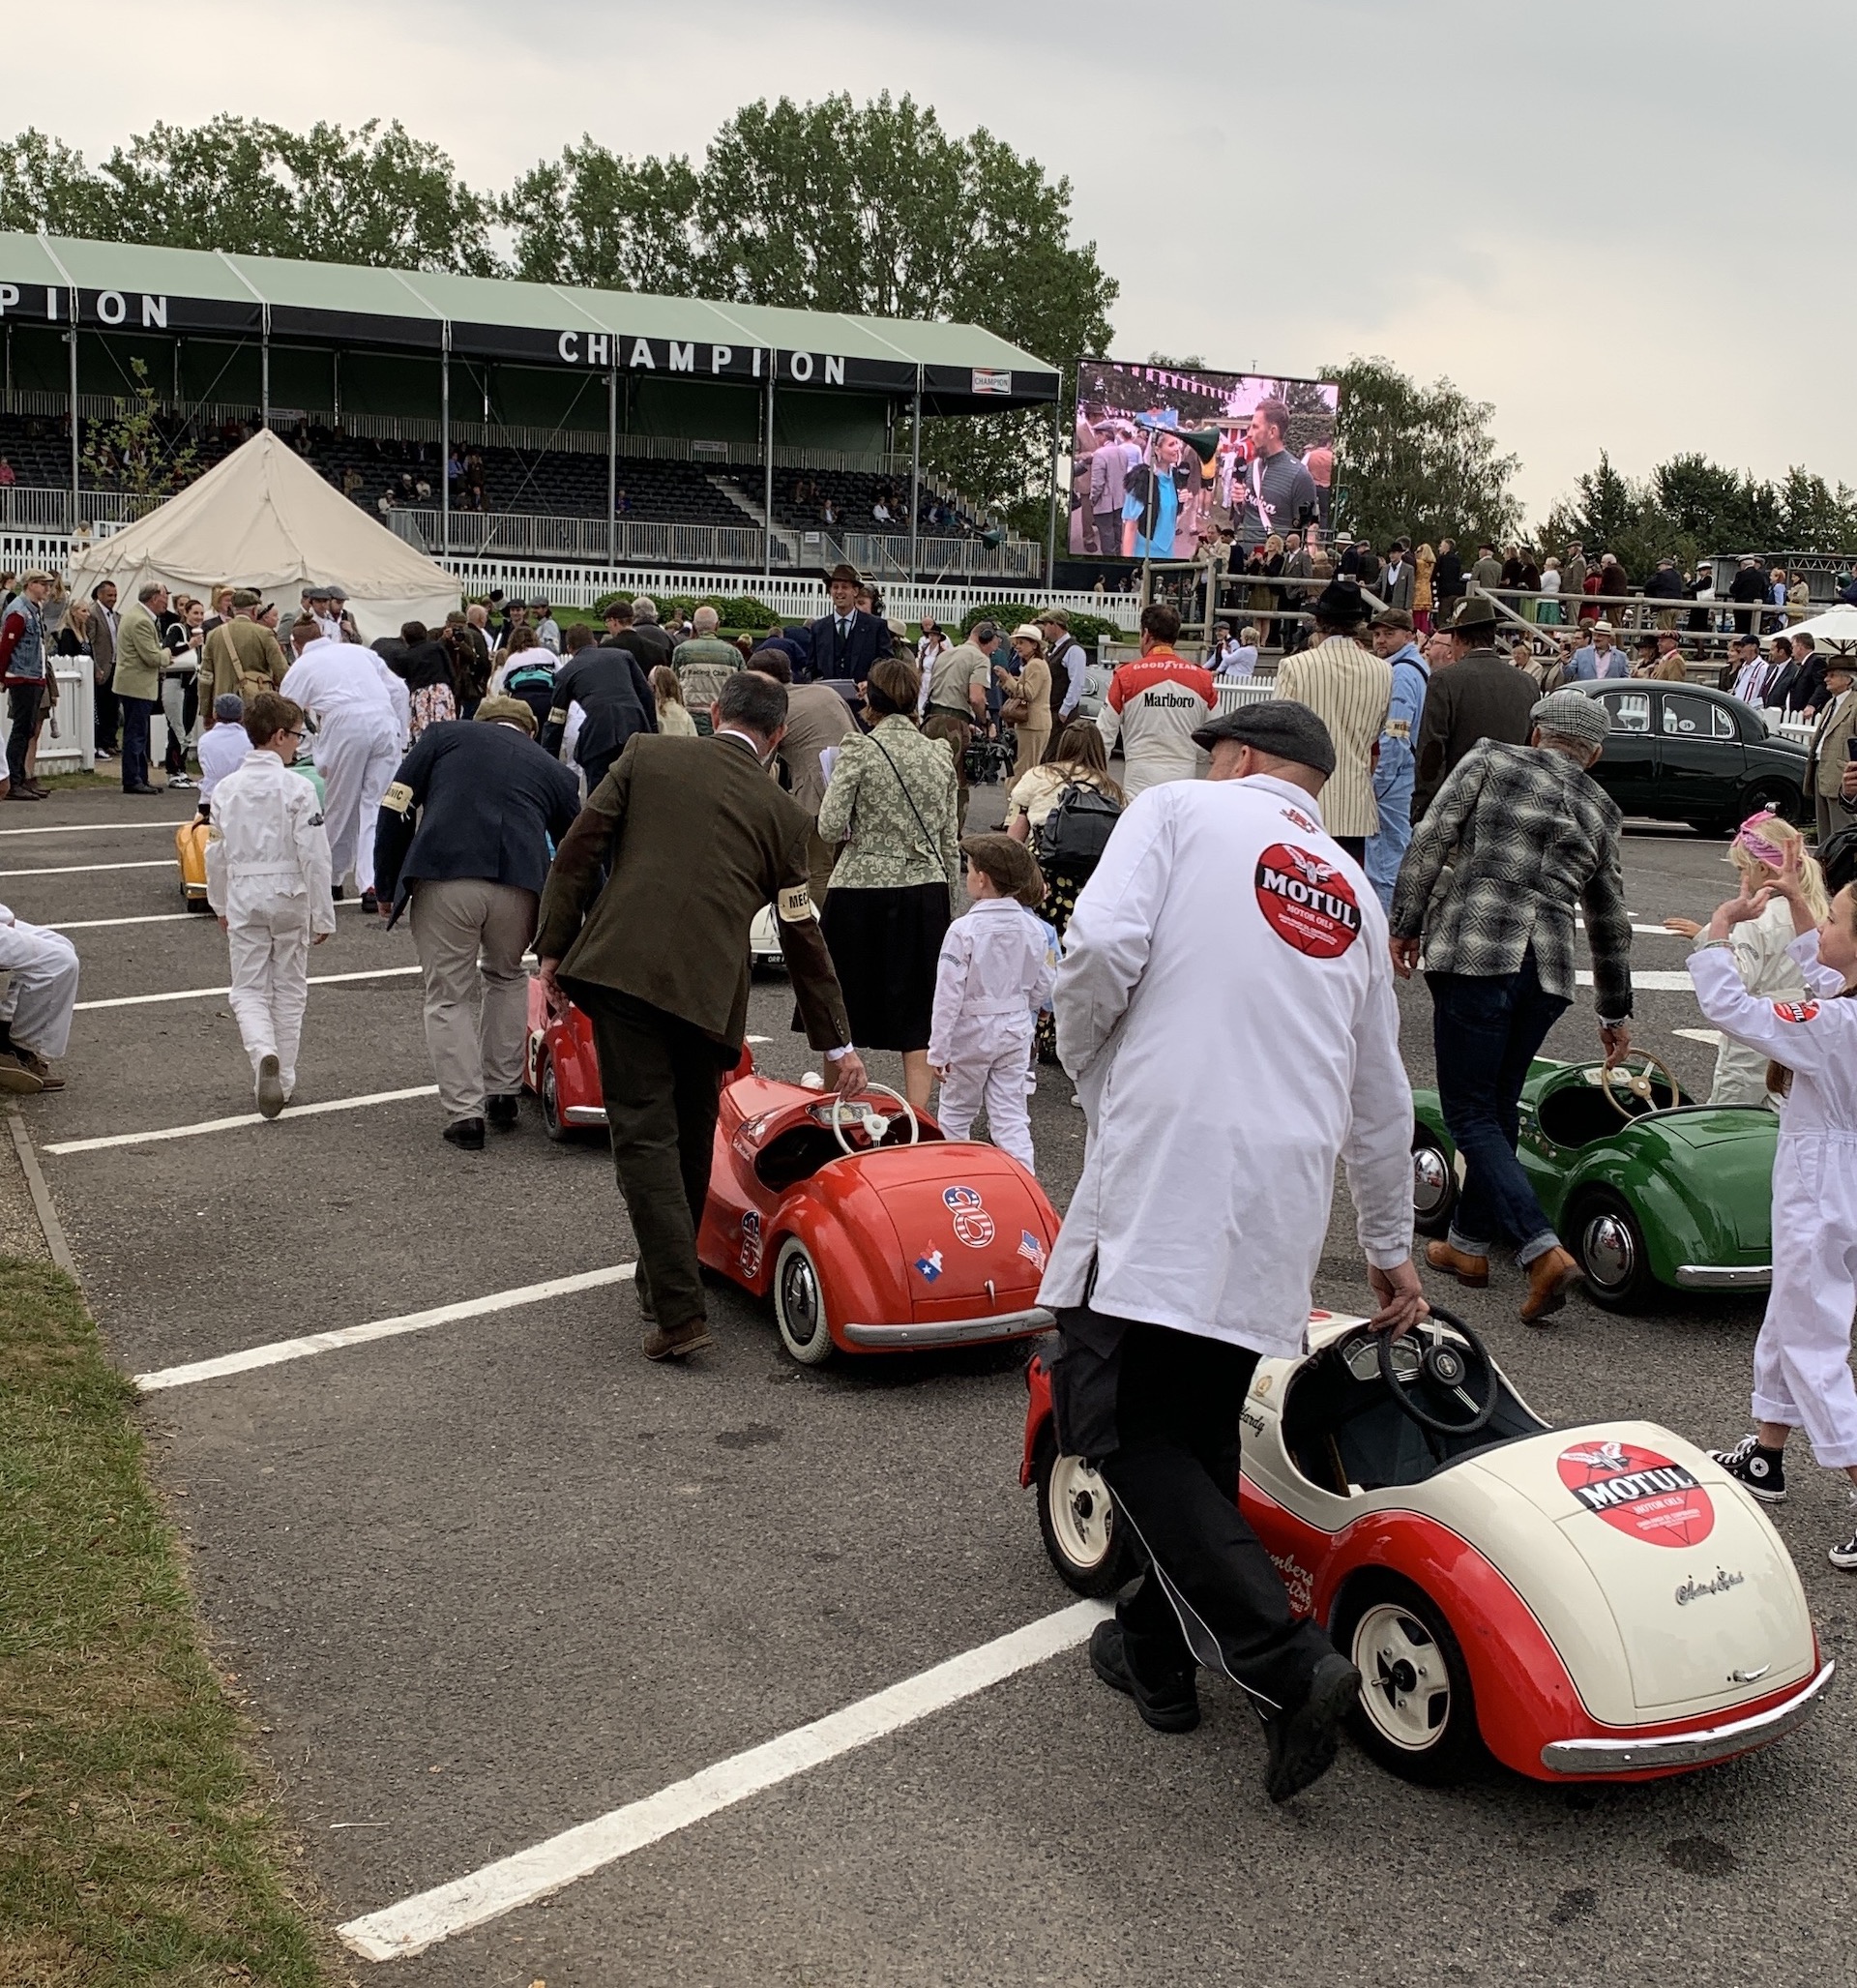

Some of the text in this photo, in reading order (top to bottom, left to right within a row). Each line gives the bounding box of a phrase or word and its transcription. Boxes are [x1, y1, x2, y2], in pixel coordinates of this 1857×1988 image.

[558, 331, 845, 386] CHAMPION
[974, 376, 1008, 387] CHAMPION
[688, 668, 711, 677] Racing
[1133, 660, 1197, 671] GOODYEAR
[1144, 692, 1194, 708] Marlboro
[1262, 868, 1356, 930] MOTUL
[1286, 904, 1315, 923] MOTOR
[1315, 916, 1334, 930] OILS
[942, 1185, 995, 1249] 8
[1578, 1467, 1695, 1509] MOTUL
[1632, 1496, 1686, 1515] MOTOR OILS
